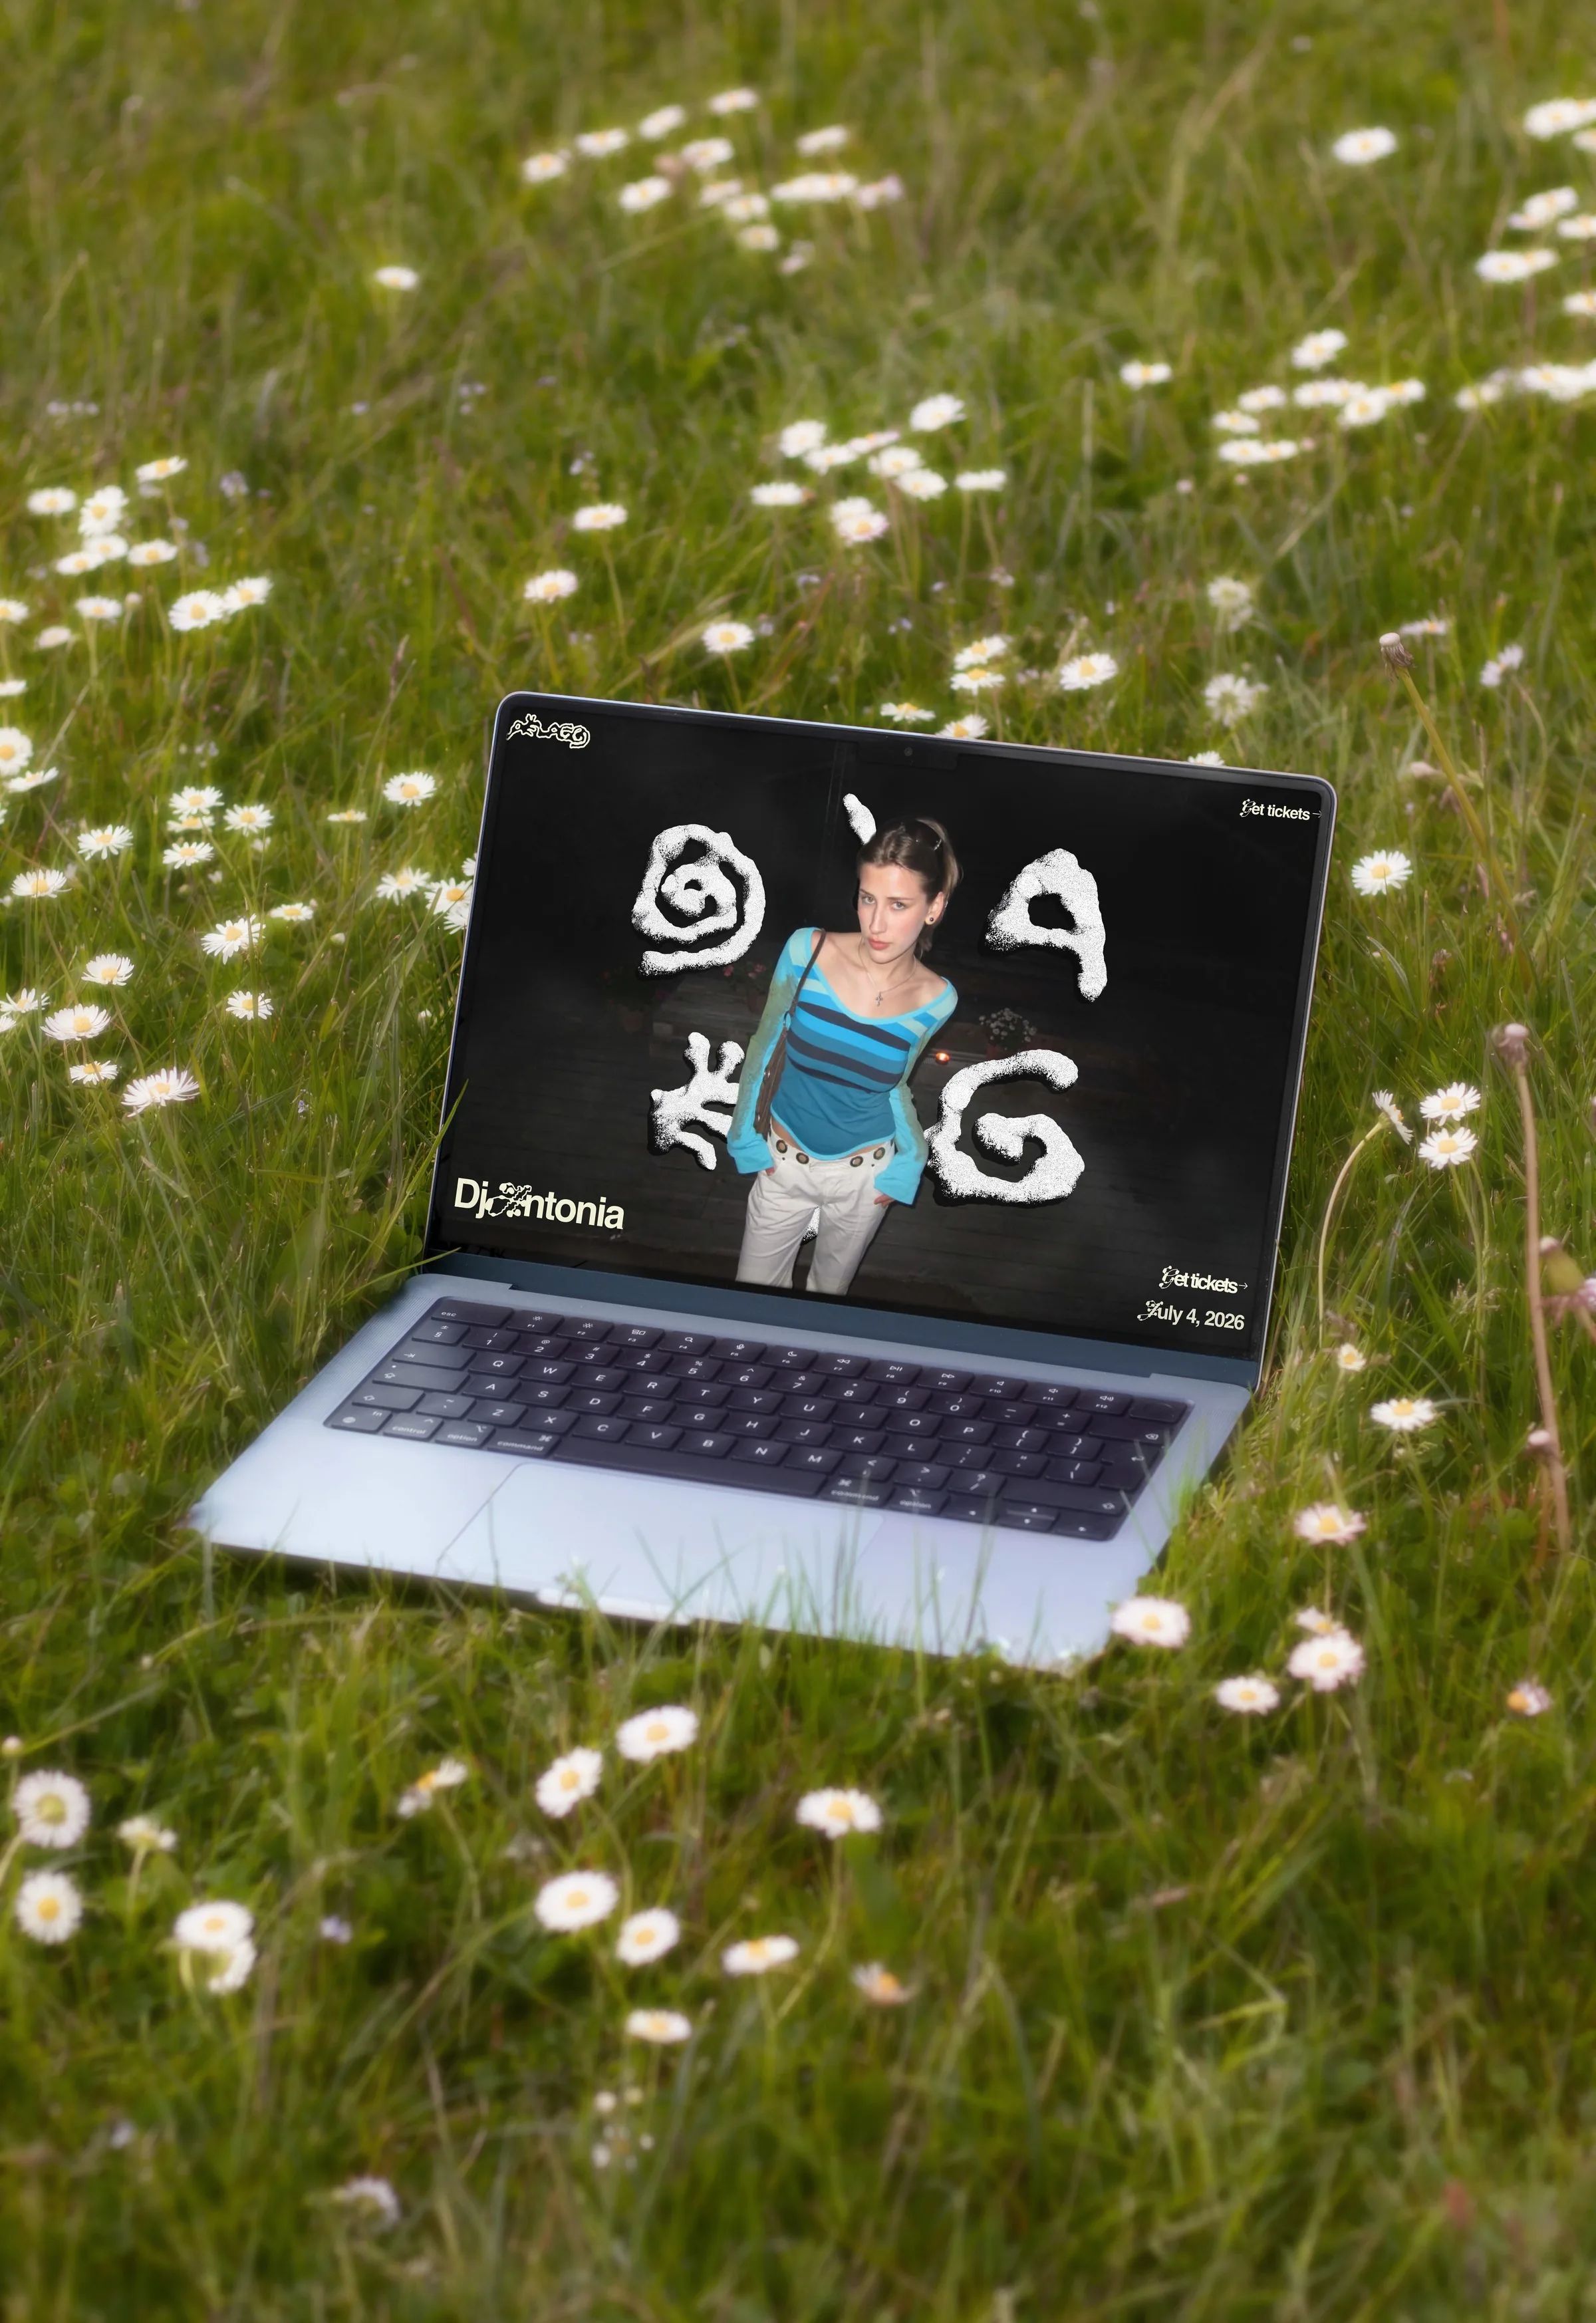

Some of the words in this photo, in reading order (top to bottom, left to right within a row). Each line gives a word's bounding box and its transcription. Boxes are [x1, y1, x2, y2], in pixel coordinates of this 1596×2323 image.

[1239, 799, 1265, 817] Get
[1267, 804, 1311, 821] tickets
[1158, 1265, 1189, 1290] Get
[1190, 1273, 1238, 1294] tickets
[1136, 1300, 1184, 1325] July
[1186, 1308, 1200, 1327] 4,
[1204, 1310, 1246, 1330] 2026
[392, 1425, 426, 1435] control
[447, 1433, 477, 1442] option
[694, 1413, 706, 1421] G
[745, 1420, 759, 1429] H
[853, 1436, 865, 1444] K
[907, 1443, 915, 1452] L
[651, 1431, 662, 1440] V
[755, 1446, 768, 1456] N
[807, 1454, 823, 1464] M
